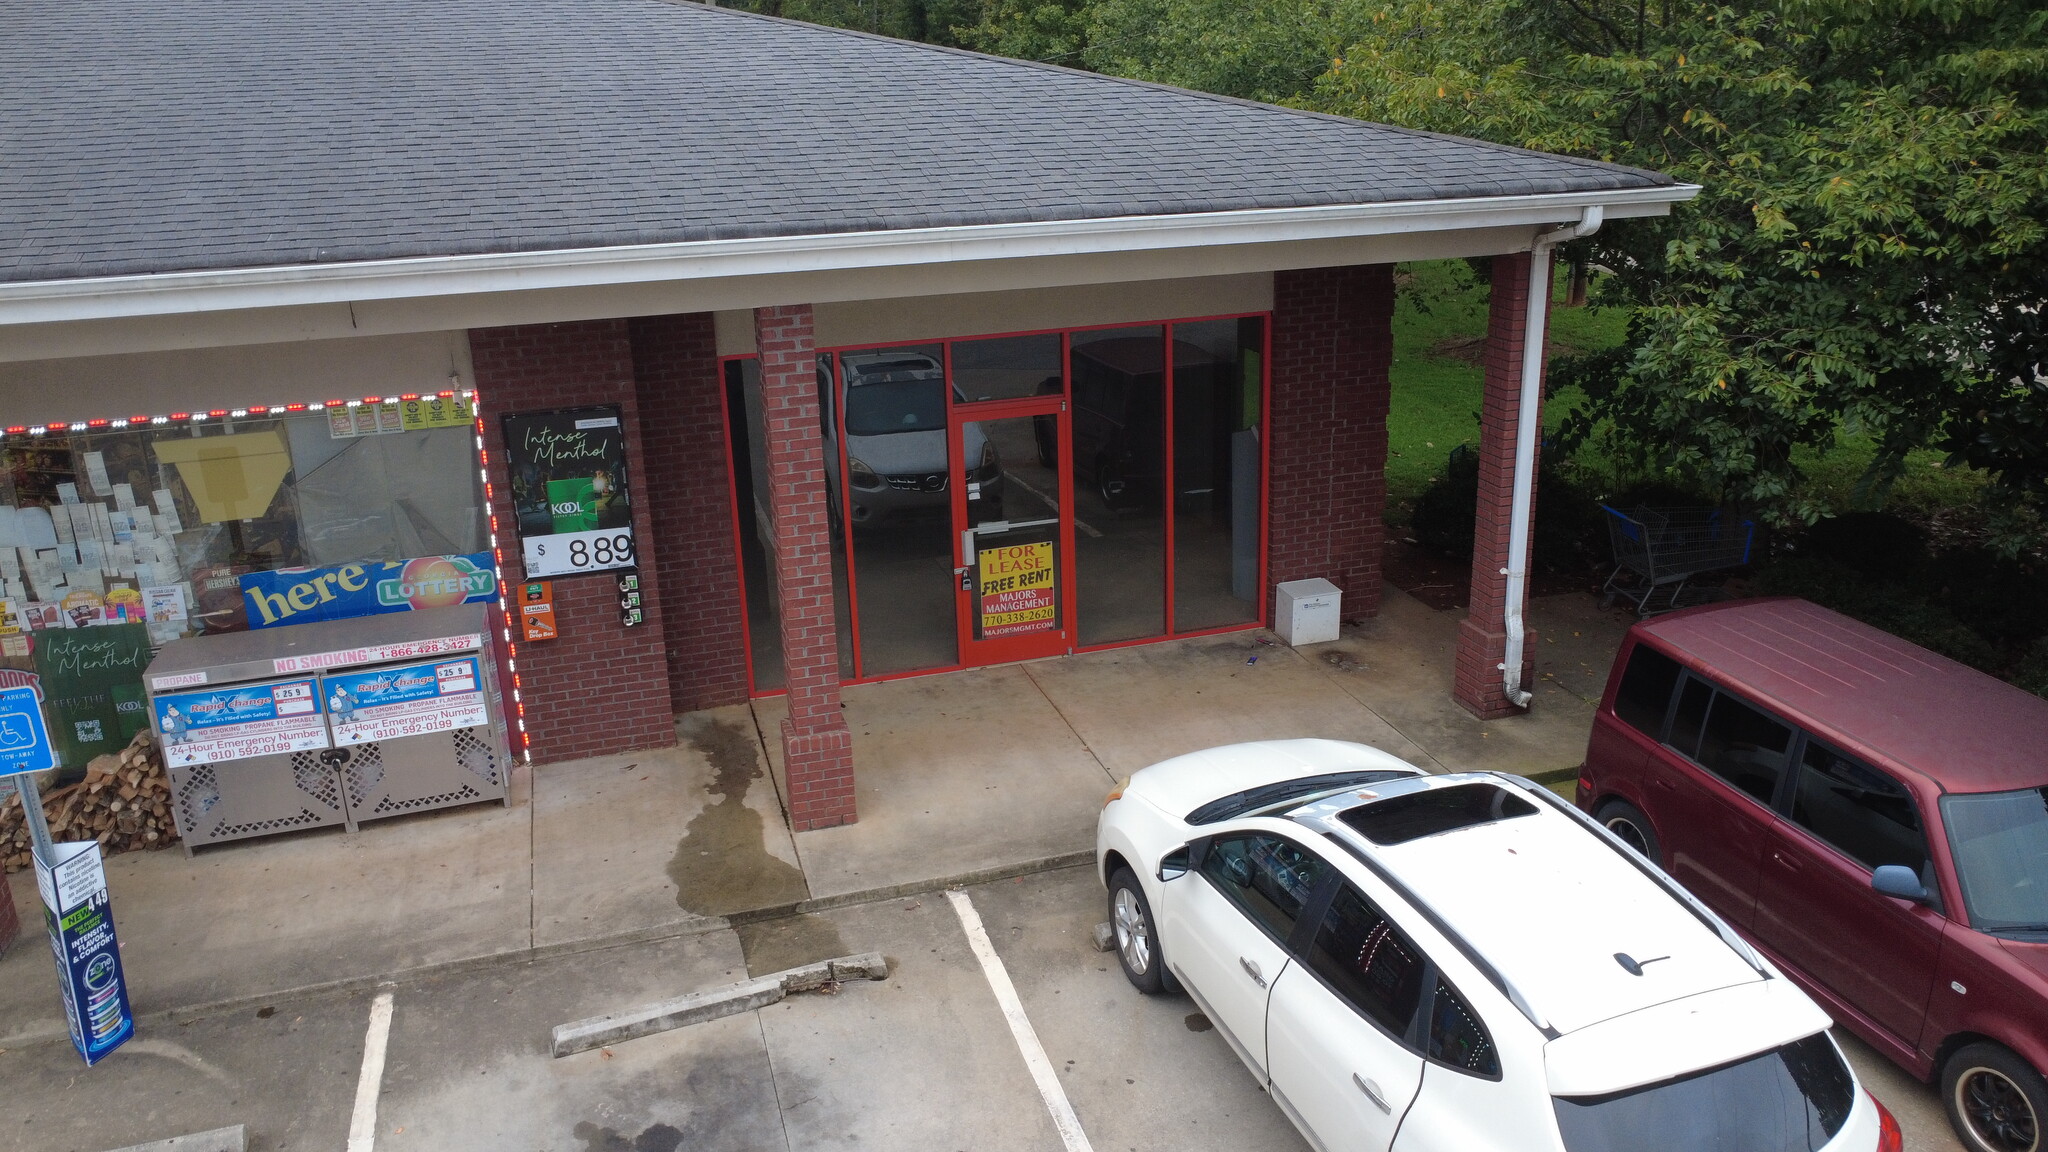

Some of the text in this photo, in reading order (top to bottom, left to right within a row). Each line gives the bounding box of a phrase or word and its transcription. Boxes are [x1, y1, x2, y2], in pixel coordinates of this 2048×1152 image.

[525, 426, 588, 450] Intense
[534, 438, 607, 467] Menthol
[551, 502, 584, 515] KOOL
[537, 544, 546, 557] $
[998, 545, 1035, 560] FOR
[212, 568, 232, 578] PURE
[989, 556, 1045, 575] LEASE
[385, 574, 488, 600] LOTTERY
[981, 568, 1052, 596] FREE RENT
[245, 564, 369, 626] here
[1000, 589, 1037, 603] MAJORS
[986, 597, 1051, 615] MANAGEMENT
[984, 608, 1053, 626] 770-338-2620
[985, 621, 1054, 636] MAJORSMGMT.COM
[47, 636, 116, 662] Intense
[58, 648, 139, 678] Menthol
[276, 649, 368, 673] NO SMOKING
[156, 674, 202, 687] PROPANE
[283, 689, 293, 697] 25
[116, 701, 145, 712] KOOL
[374, 705, 404, 713] SMOKING
[409, 700, 438, 708] PROPANE
[439, 694, 477, 704] FLAMMABLE
[209, 725, 240, 735] SMOKING
[245, 721, 275, 730] PROPANE
[277, 716, 317, 726] FLAMMABLE
[338, 707, 484, 734] 24-Hour Emergency Number:
[171, 729, 324, 756] 24-Hour Emergency Number:
[207, 742, 291, 761] (910) 592-0199
[1, 750, 35, 761] TOW-AWAY
[71, 921, 109, 949] INTENSITY,
[78, 932, 107, 953] FLAVOR,
[73, 956, 80, 964] &
[80, 933, 114, 960] COMFORT
